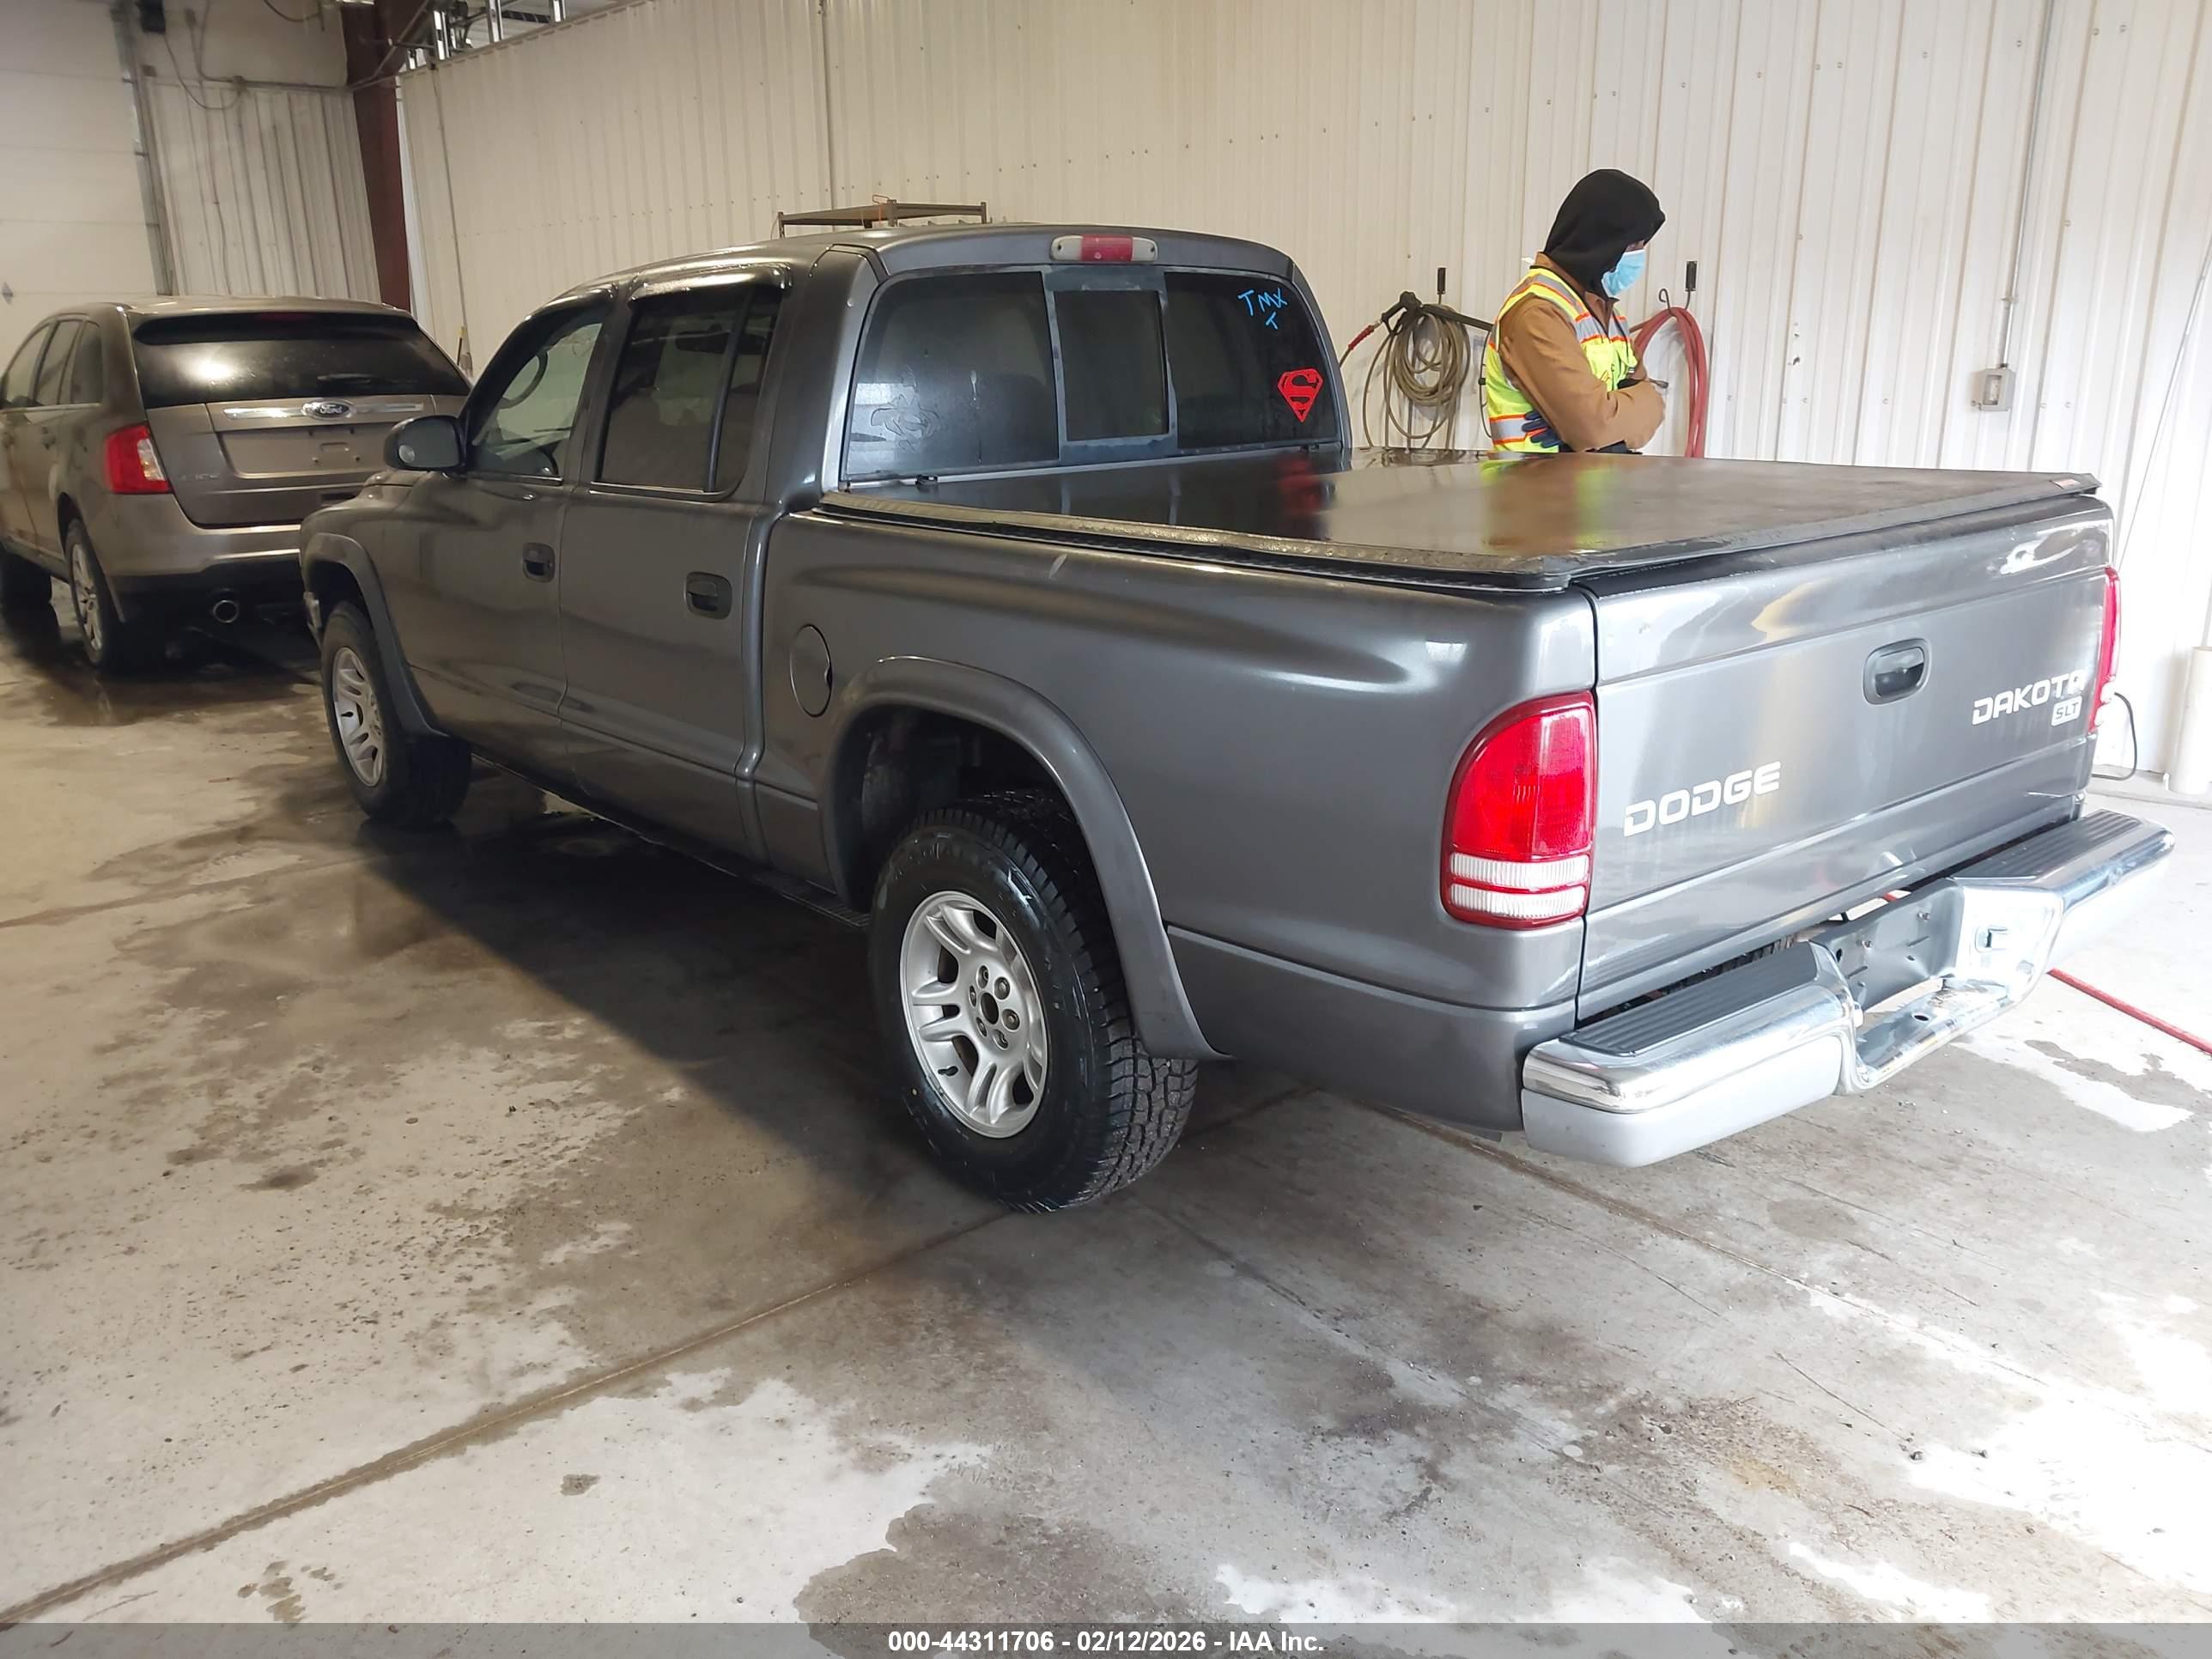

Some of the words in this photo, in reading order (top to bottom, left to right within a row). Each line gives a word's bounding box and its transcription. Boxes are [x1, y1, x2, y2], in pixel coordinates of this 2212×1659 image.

[1972, 669, 2088, 726] DAKOTA
[2054, 700, 2080, 721] SLT
[1623, 761, 1781, 837] DODGE
